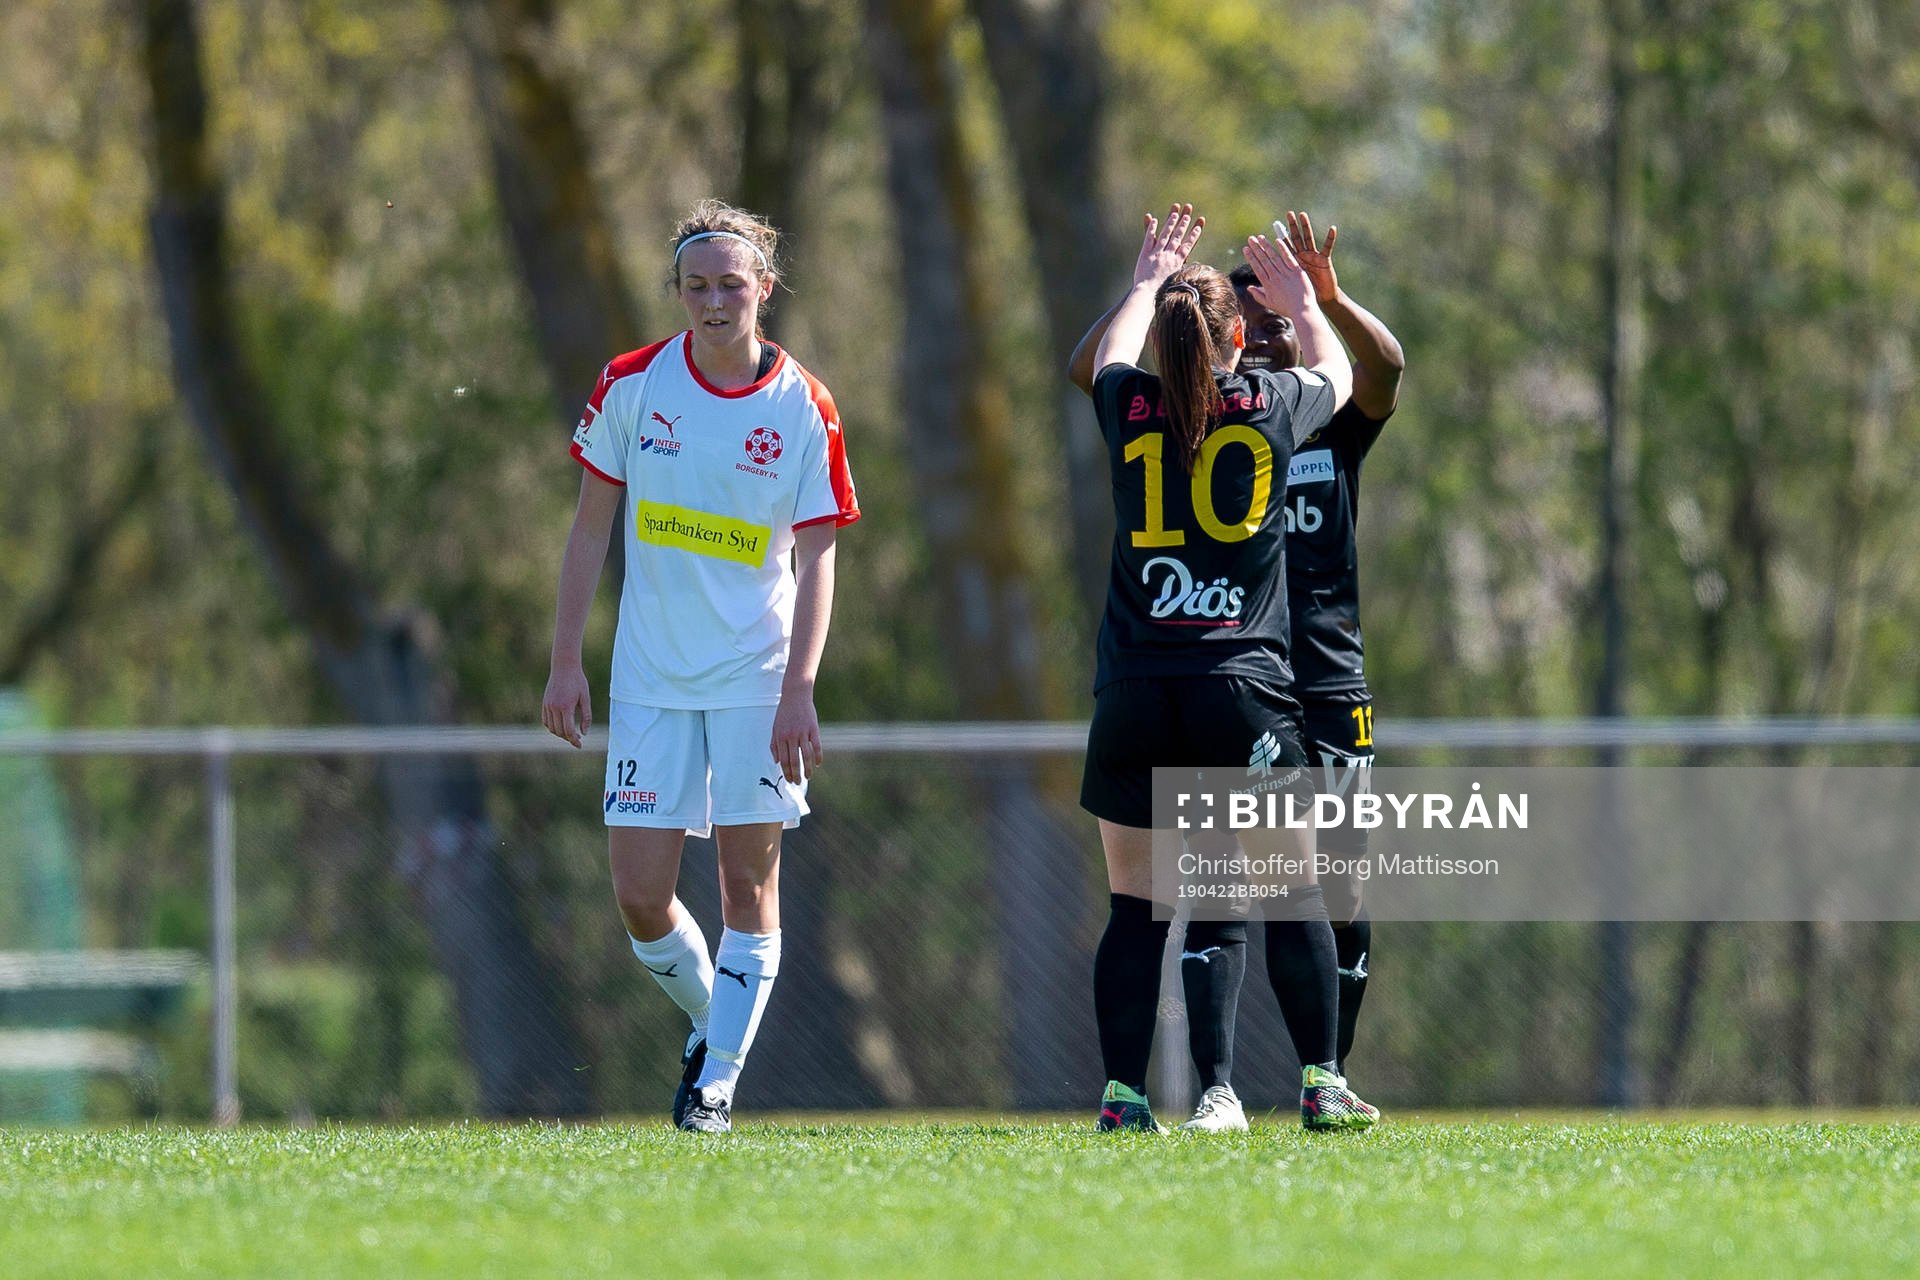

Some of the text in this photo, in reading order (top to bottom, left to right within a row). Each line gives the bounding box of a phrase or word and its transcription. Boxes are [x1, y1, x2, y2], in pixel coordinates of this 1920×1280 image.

[653, 446, 680, 457] SPORT
[655, 438, 681, 449] INTER
[735, 462, 779, 480] BORGEBY FK
[1287, 462, 1332, 478] UPPEN
[1124, 424, 1273, 548] 10
[644, 511, 758, 553] Sparbanken Syd
[1142, 556, 1245, 618] Diös
[617, 759, 637, 787] 12
[618, 791, 657, 803] INTER
[617, 802, 657, 814] SPORT
